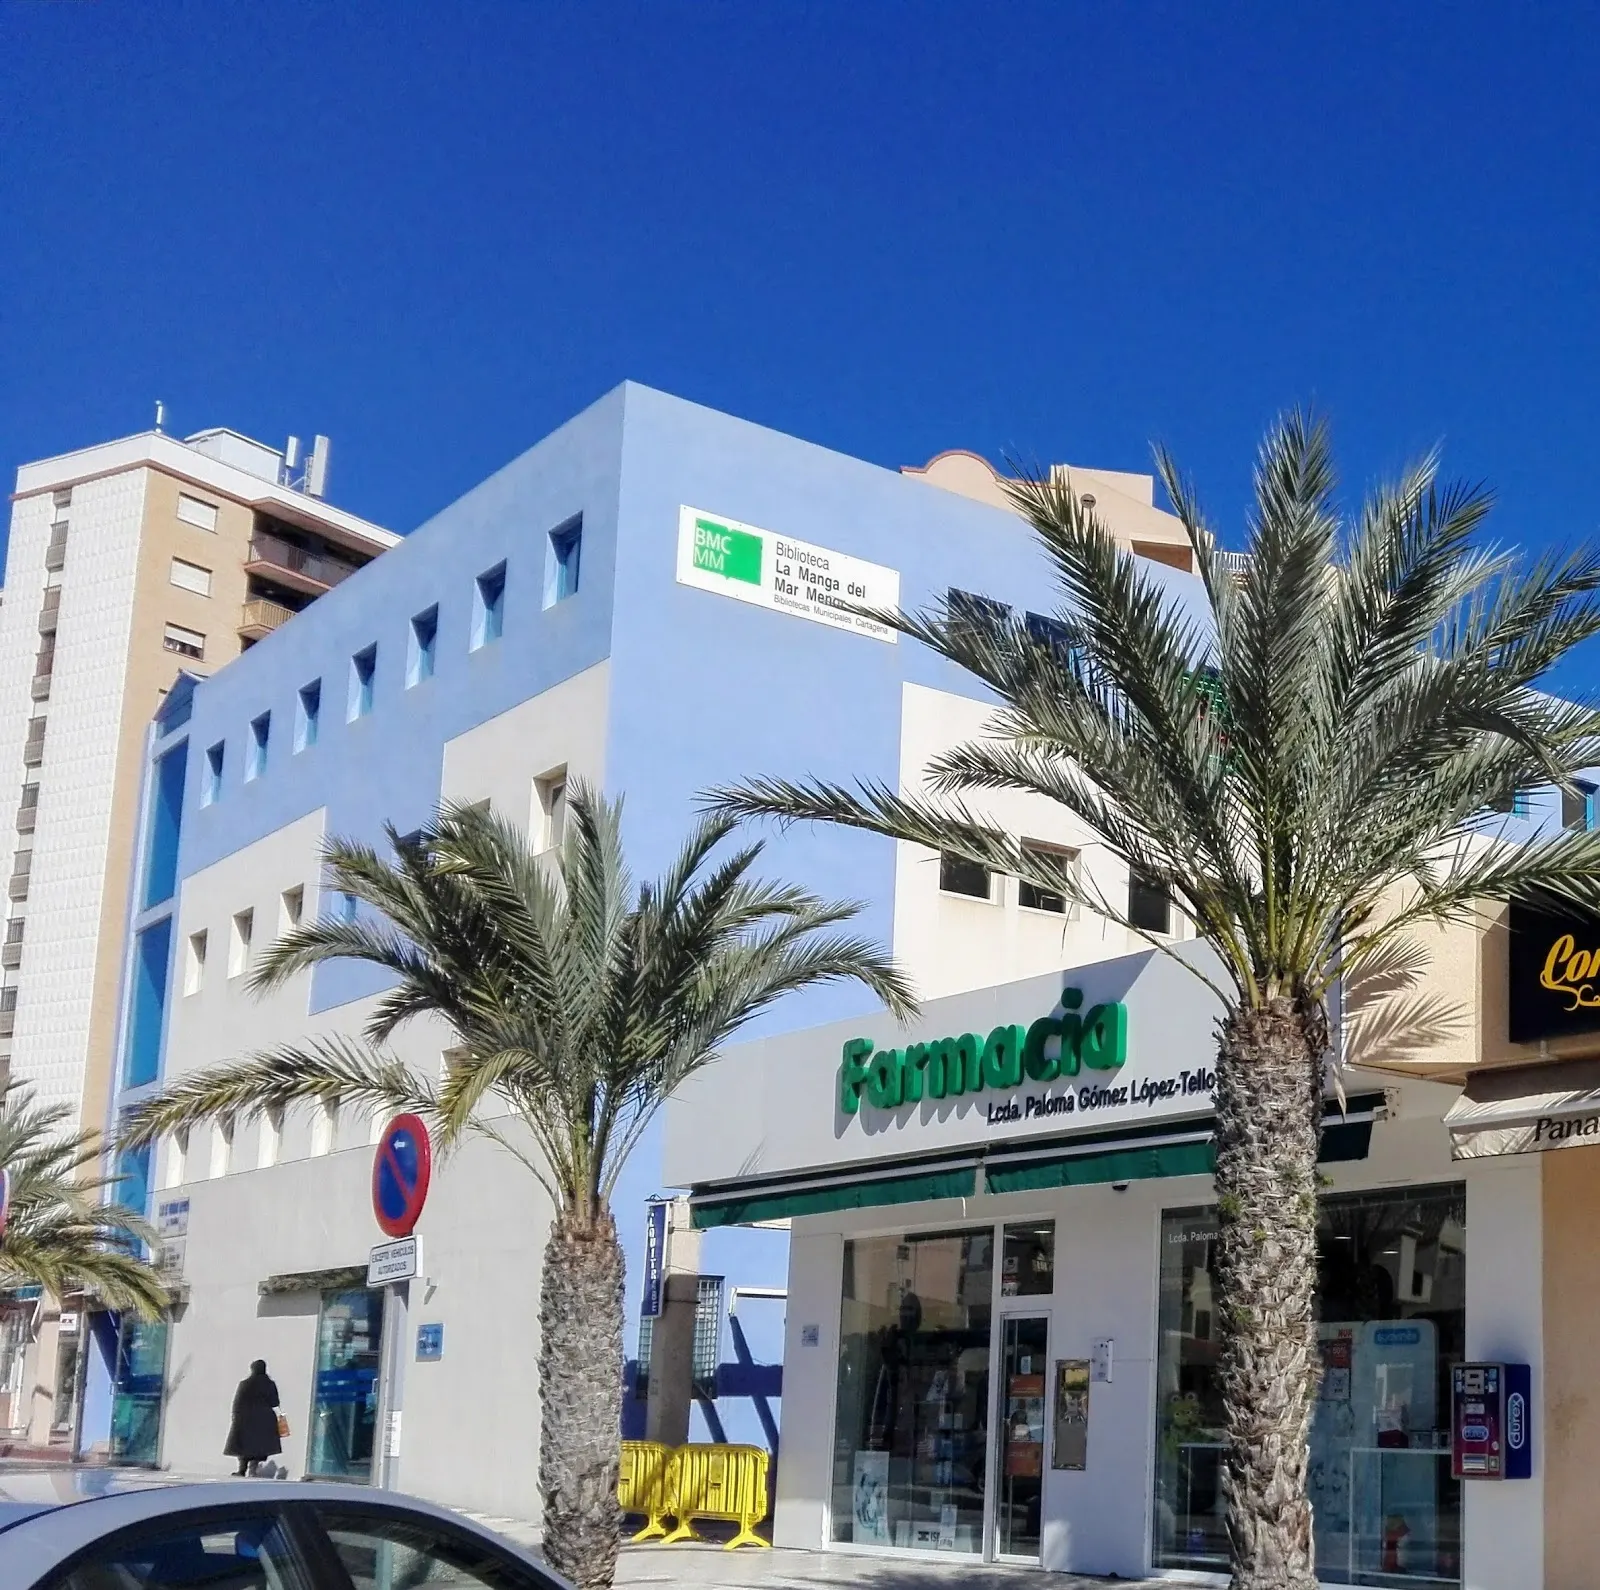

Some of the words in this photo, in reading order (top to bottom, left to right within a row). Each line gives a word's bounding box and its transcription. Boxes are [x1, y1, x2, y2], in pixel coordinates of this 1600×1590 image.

[694, 527, 732, 555] BMC
[776, 541, 830, 571] Biblioteca
[693, 549, 725, 571] MM
[774, 577, 799, 596] Mar
[806, 586, 847, 608] Menor
[775, 559, 791, 576] La
[799, 566, 840, 592] Manga
[847, 582, 866, 598] del
[773, 594, 810, 612] Bibliotecas
[813, 605, 852, 624] Municipales
[855, 617, 889, 635] Cartagena
[1540, 934, 1600, 989] Co
[841, 987, 1128, 1115] Farmacia
[987, 1102, 1022, 1125] Lcda.
[1025, 1093, 1076, 1118] Paloma
[1078, 1084, 1128, 1110] Gómez
[1131, 1068, 1216, 1105] López-Tello
[1168, 1233, 1189, 1243] Lcda.
[1191, 1231, 1218, 1241] Paloma
[371, 1251, 390, 1263] EXCEPTO
[1510, 1399, 1521, 1443] durex
